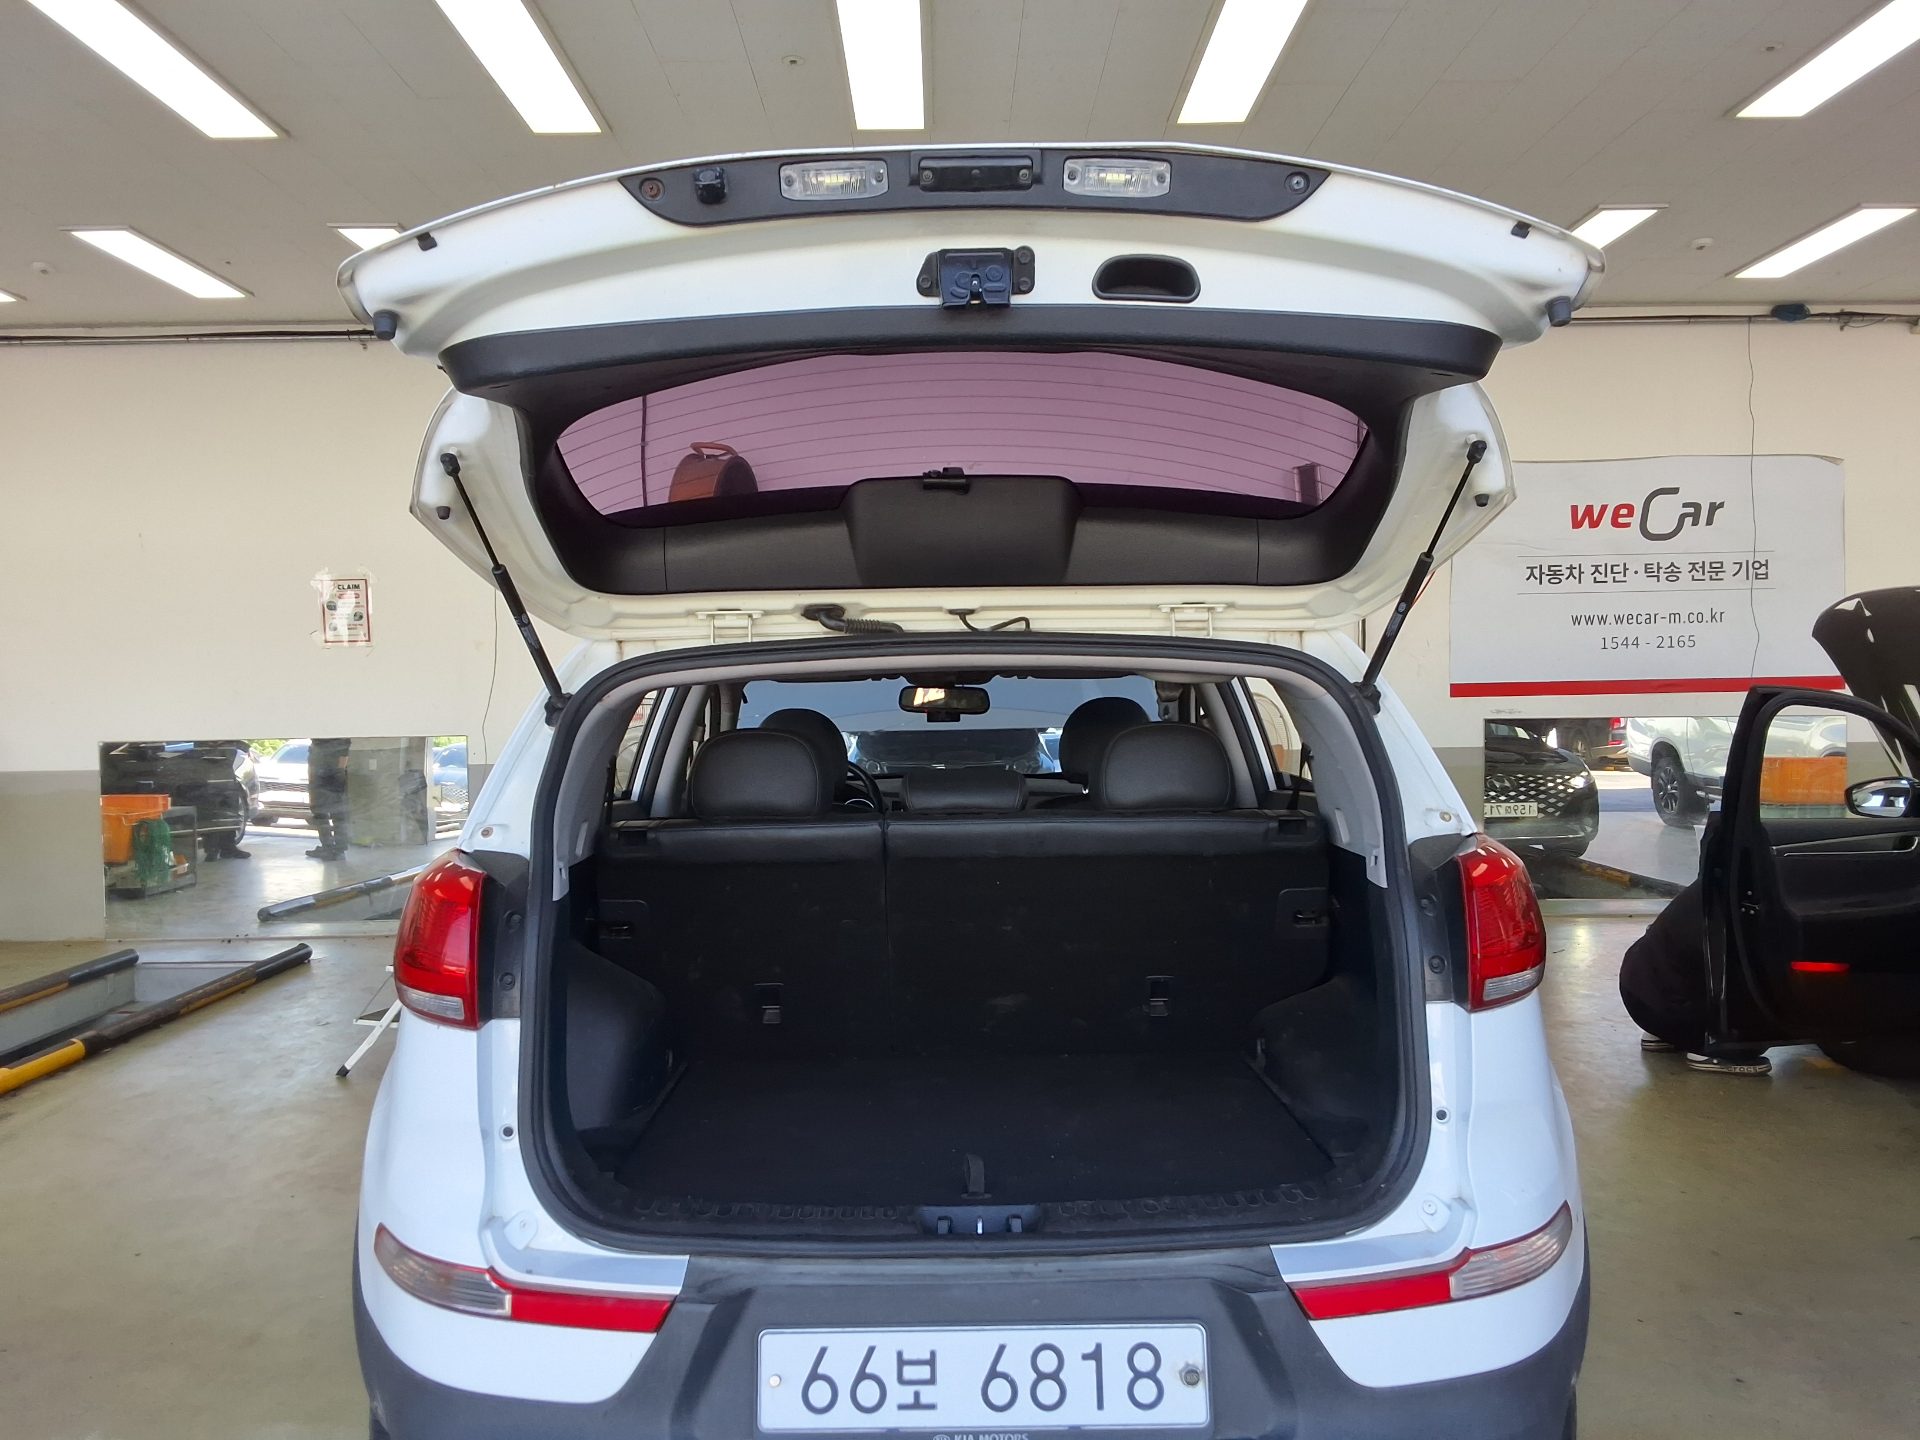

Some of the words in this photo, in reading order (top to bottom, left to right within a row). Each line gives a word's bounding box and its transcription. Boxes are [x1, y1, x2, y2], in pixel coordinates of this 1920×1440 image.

[1570, 486, 1725, 541] weCar
[1525, 563, 1584, 586] 자동차
[1687, 560, 1726, 582] 전문
[1732, 559, 1770, 581] 기업
[1571, 608, 1725, 626] www.wecar-m.co.kr
[1600, 636, 1640, 650] 1544
[1656, 634, 1696, 649] 2165
[801, 1345, 937, 1415] 66보
[981, 1341, 1165, 1412] 6818
